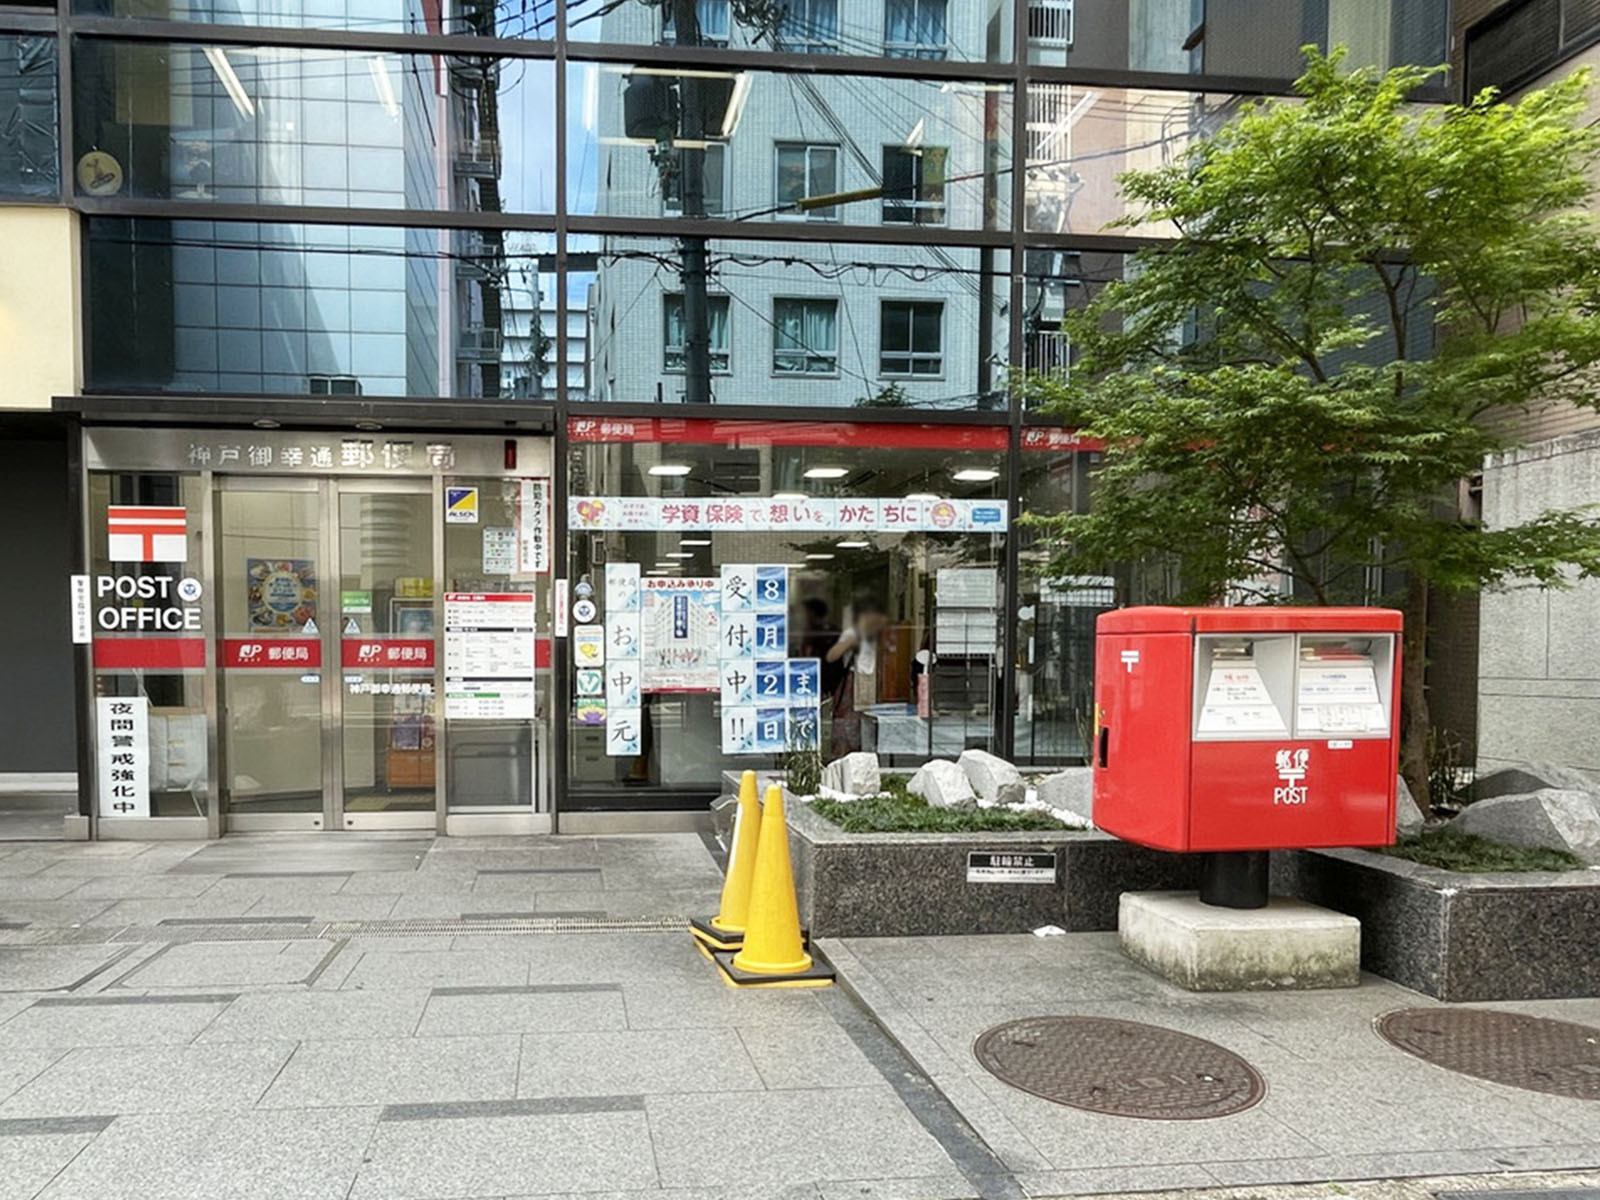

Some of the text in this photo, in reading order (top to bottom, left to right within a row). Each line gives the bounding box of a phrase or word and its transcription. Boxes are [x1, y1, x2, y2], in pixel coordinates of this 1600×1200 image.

[600, 423, 635, 436] 郵便局
[448, 511, 476, 519] ALSOK
[98, 576, 173, 598] POST
[99, 607, 202, 630] OFFICE
[268, 647, 309, 660] 郵便局
[387, 647, 427, 660] 郵便局
[611, 624, 638, 743] お中元
[109, 702, 135, 813] 夜間警戒強化中
[1275, 748, 1311, 769] 郵便
[1274, 786, 1309, 805] POST
